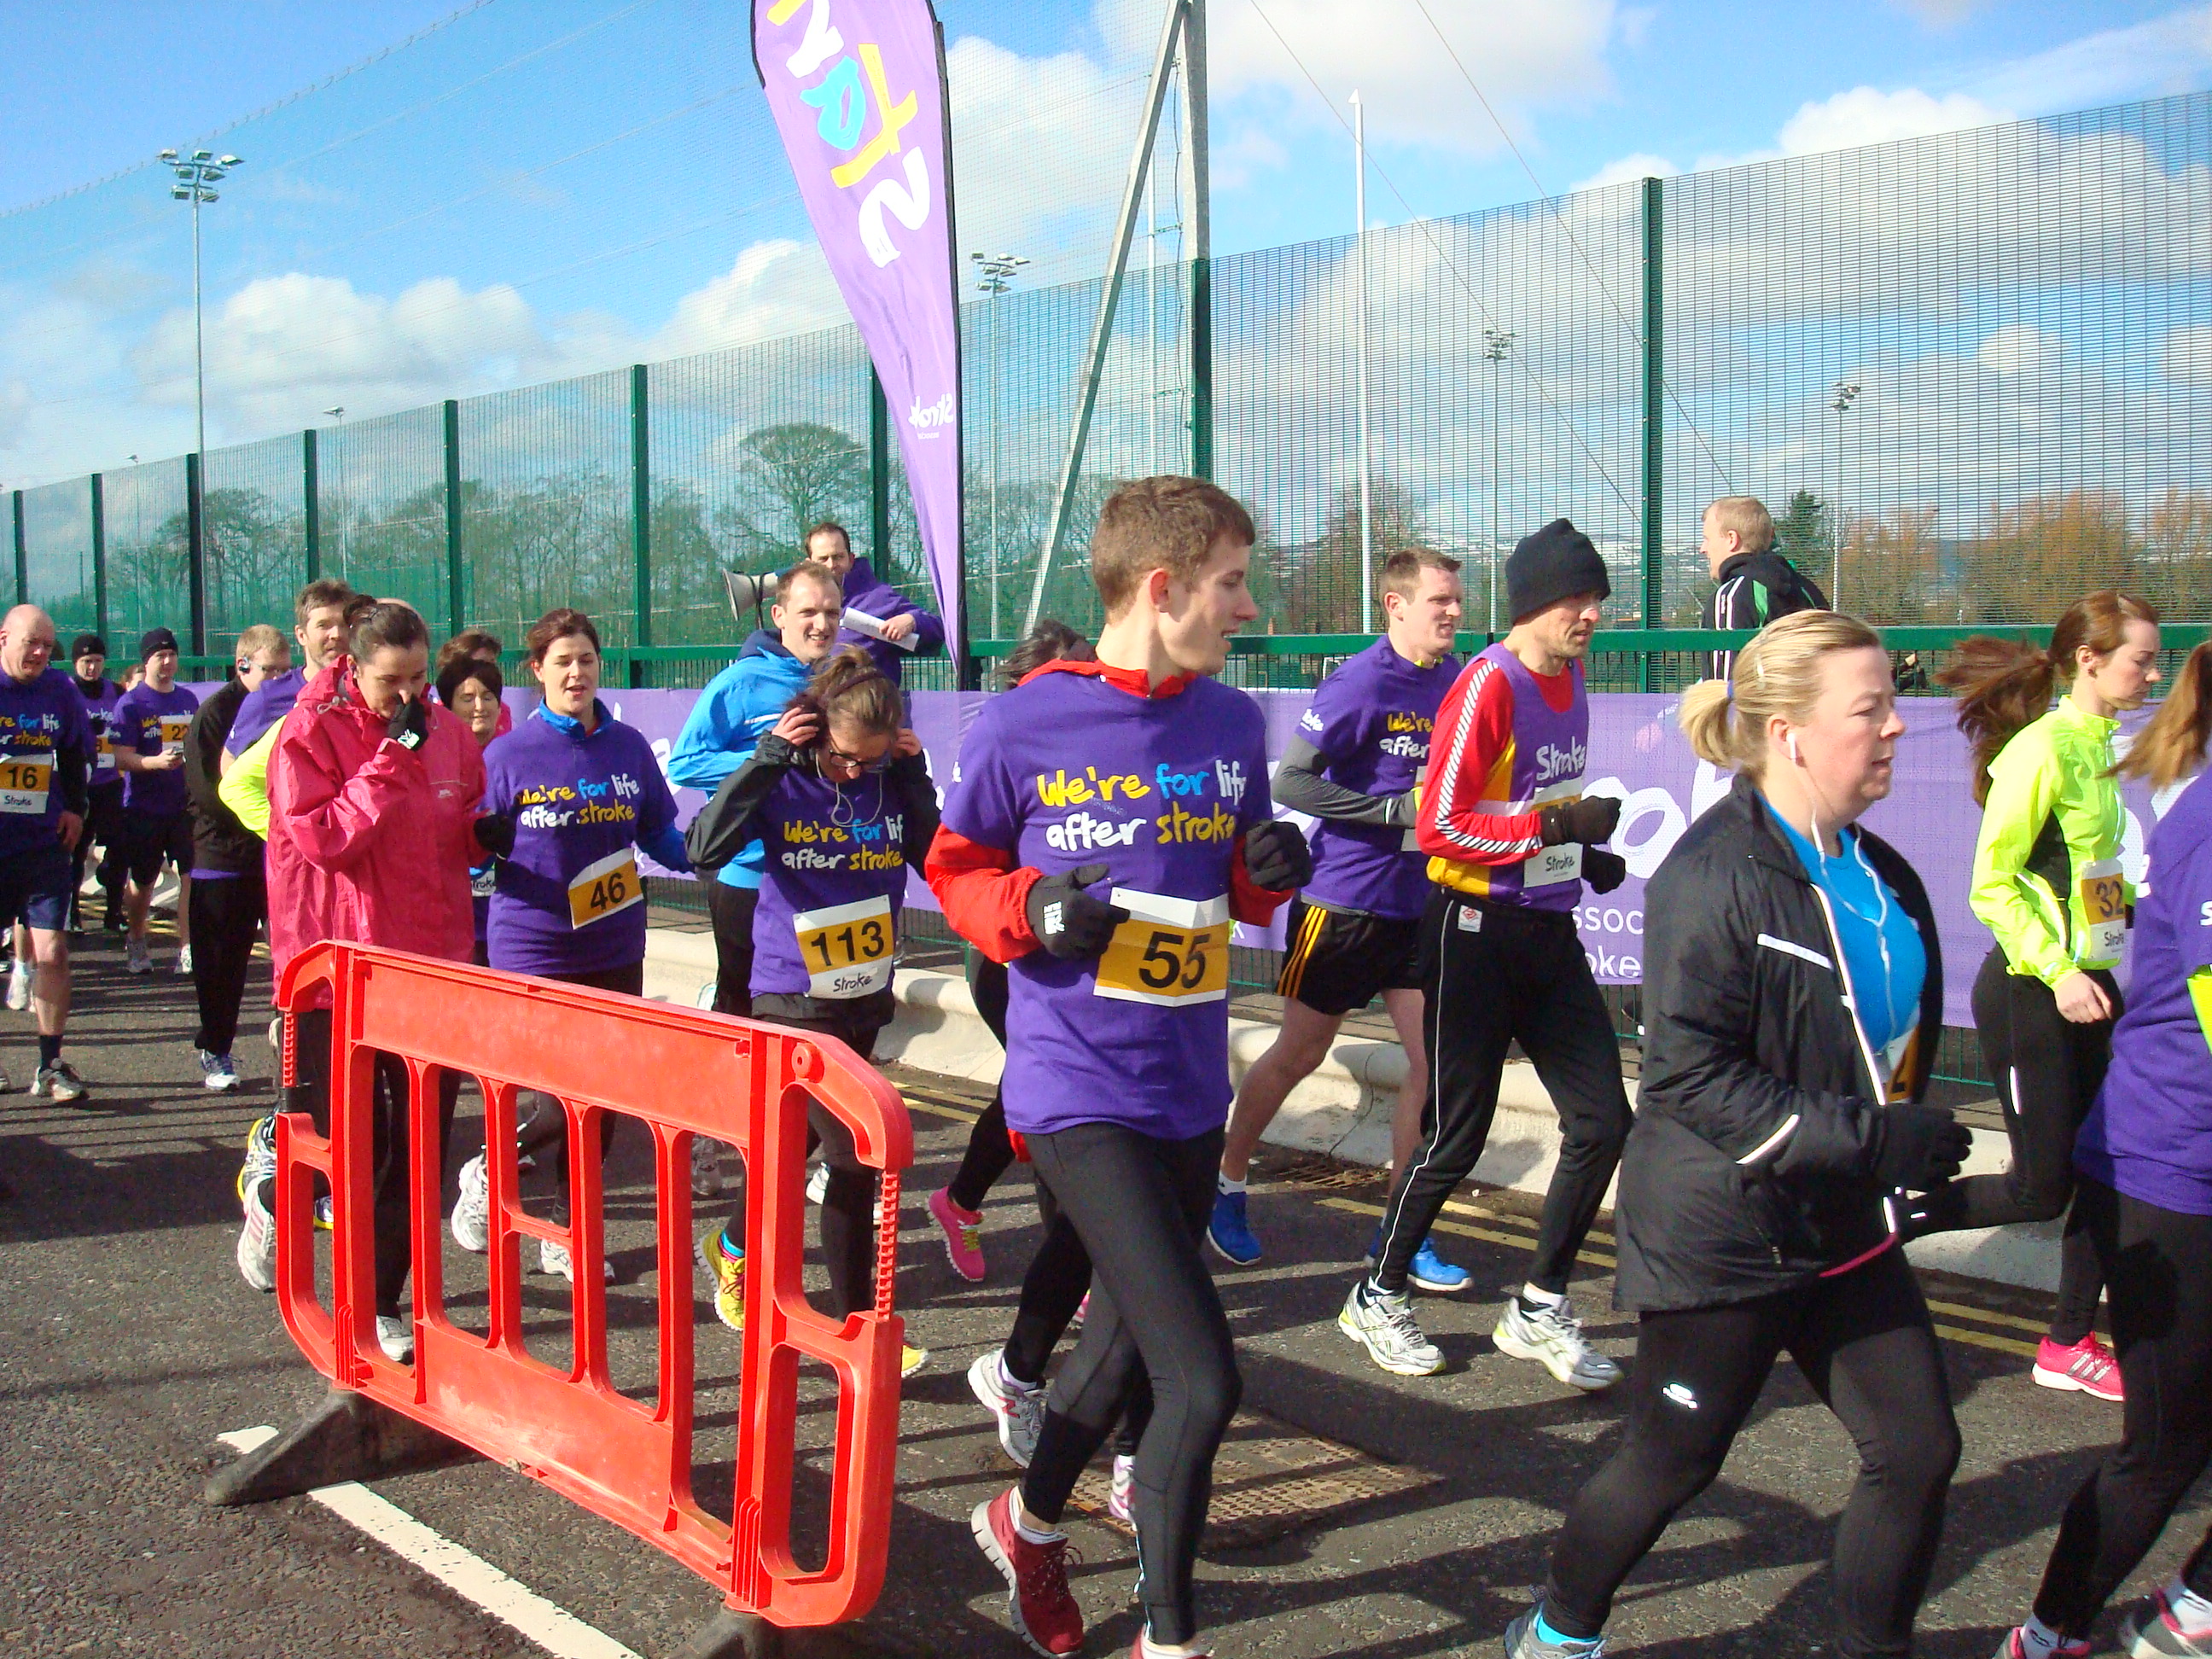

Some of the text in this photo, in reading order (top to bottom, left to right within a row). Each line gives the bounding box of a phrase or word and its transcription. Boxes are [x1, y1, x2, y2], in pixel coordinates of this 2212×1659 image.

[19, 713, 42, 729] for
[42, 713, 61, 732] life
[1387, 711, 1433, 733] We're
[14, 730, 52, 747] stroke
[1379, 735, 1430, 759] after
[1536, 736, 1587, 781] Stroke
[8, 765, 38, 789] 16
[577, 777, 609, 800] for
[611, 772, 640, 800] life
[1037, 765, 1151, 807] We're
[1155, 763, 1209, 800] for
[4, 795, 32, 806] Stroke
[520, 799, 636, 829] after stroke
[783, 813, 904, 844] We're for lif
[1045, 811, 1148, 852] after
[781, 842, 904, 871] after stroke
[1545, 852, 1575, 871] Stroke
[590, 872, 626, 911] 46
[2095, 880, 2124, 918] 32
[811, 920, 885, 967] 113
[1138, 930, 1211, 989] 55
[833, 973, 873, 992] Stroke
